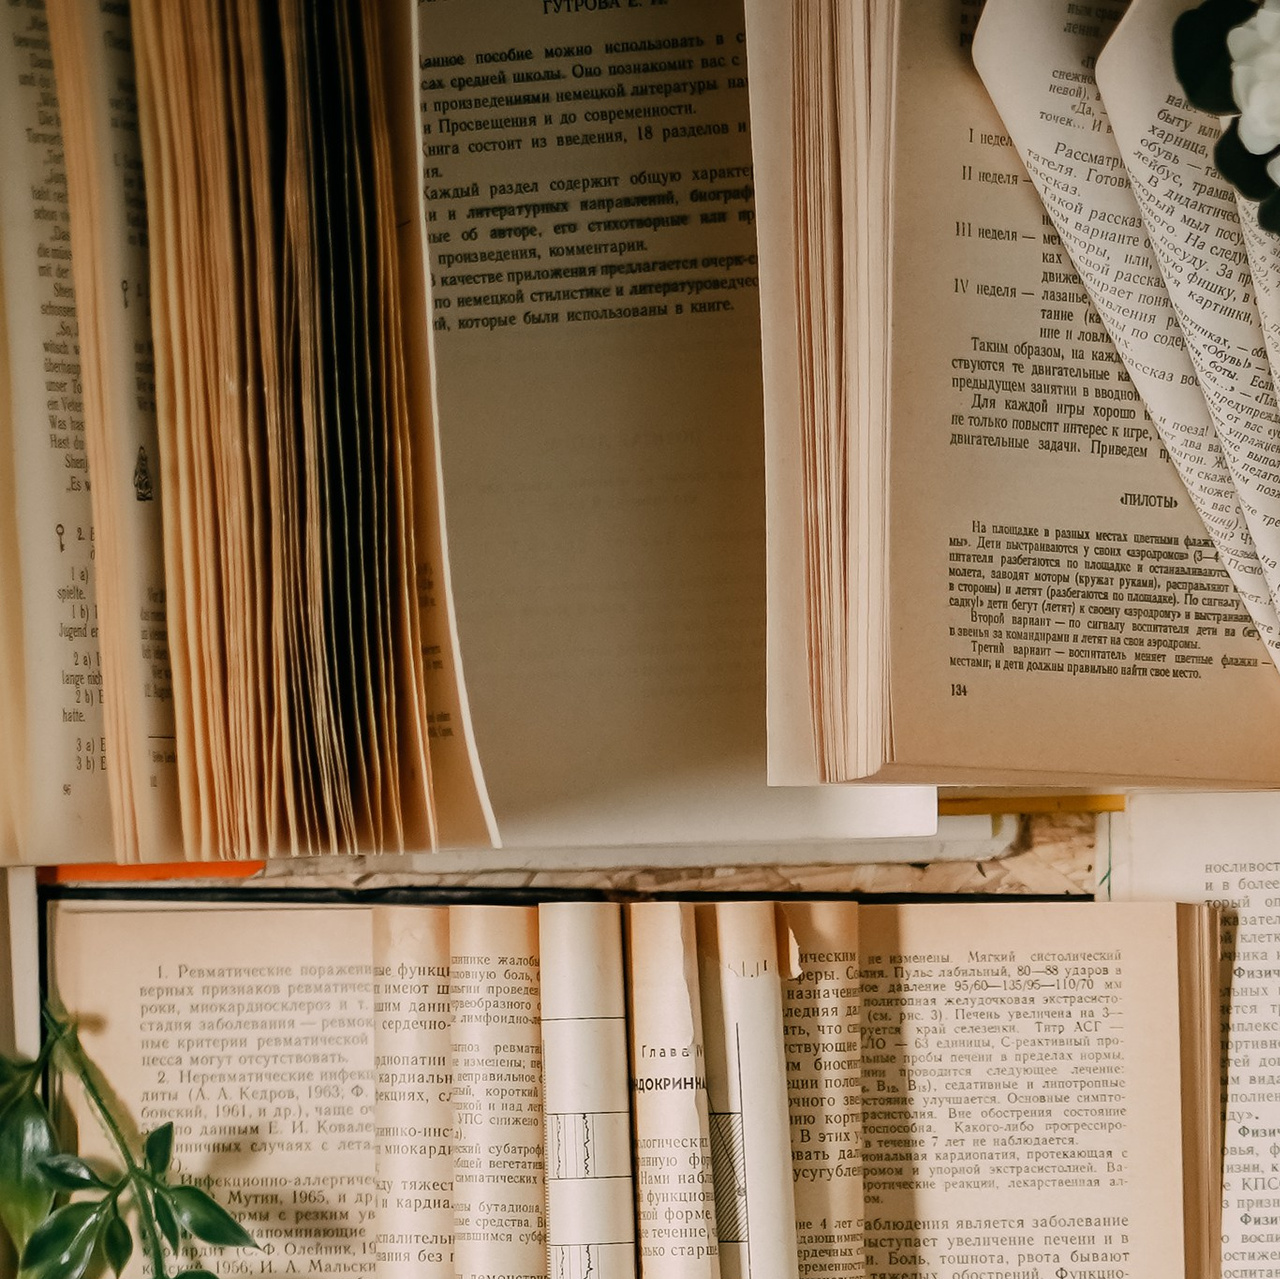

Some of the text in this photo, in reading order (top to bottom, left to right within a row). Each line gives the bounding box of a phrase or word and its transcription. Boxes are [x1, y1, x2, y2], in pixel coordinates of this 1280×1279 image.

[475, 36, 704, 64] пособие можно использовать
[450, 56, 726, 91] средней школы. Оно познакомит вас
[433, 80, 719, 115] произведениями немецкой литературы
[438, 104, 696, 136] Просвещения до современности.
[468, 123, 729, 153] состоит из введения, 18 разделов
[489, 170, 682, 199] раздел содержит общую
[956, 221, 1017, 241] III неделя
[549, 240, 648, 257] комментарии.
[440, 272, 503, 287] качестве
[954, 278, 1016, 298] IV неделя
[457, 289, 524, 308] немецкой
[458, 300, 734, 331] которые были использованы книге.
[971, 336, 1084, 361] Таким образом, на
[1031, 364, 1110, 381] двигательные
[952, 377, 1077, 396] предыдущем занятии
[971, 393, 1136, 421] Для каждой игры хорошо
[967, 416, 1152, 442] только повысит интерес игре,
[950, 433, 1148, 458] двигательные задачи. Приведем
[1120, 493, 1178, 508] «ПИЛОТЫ»
[972, 520, 1039, 537] На площадке
[57, 586, 86, 603] spielte.
[971, 611, 1052, 628] Второй вариант
[59, 622, 87, 641] Jugend
[971, 640, 1051, 658] Третий вариант
[61, 670, 85, 689] lange
[951, 684, 967, 696] 134
[62, 707, 85, 722] hatte.
[968, 949, 1121, 963] Мягкий систолический
[178, 964, 292, 979] Ревматические
[1017, 965, 1109, 979] 80—88 ударов
[954, 978, 1094, 994] 95/60—135/95—110/70
[642, 1045, 689, 1058] Глава
[935, 1150, 1113, 1163] кардиопатия, протекающая
[956, 1215, 1129, 1229] является заболевание
[947, 1235, 1095, 1250] увеличение печени
[939, 1250, 1130, 1267] тошнота, рвота бывают
